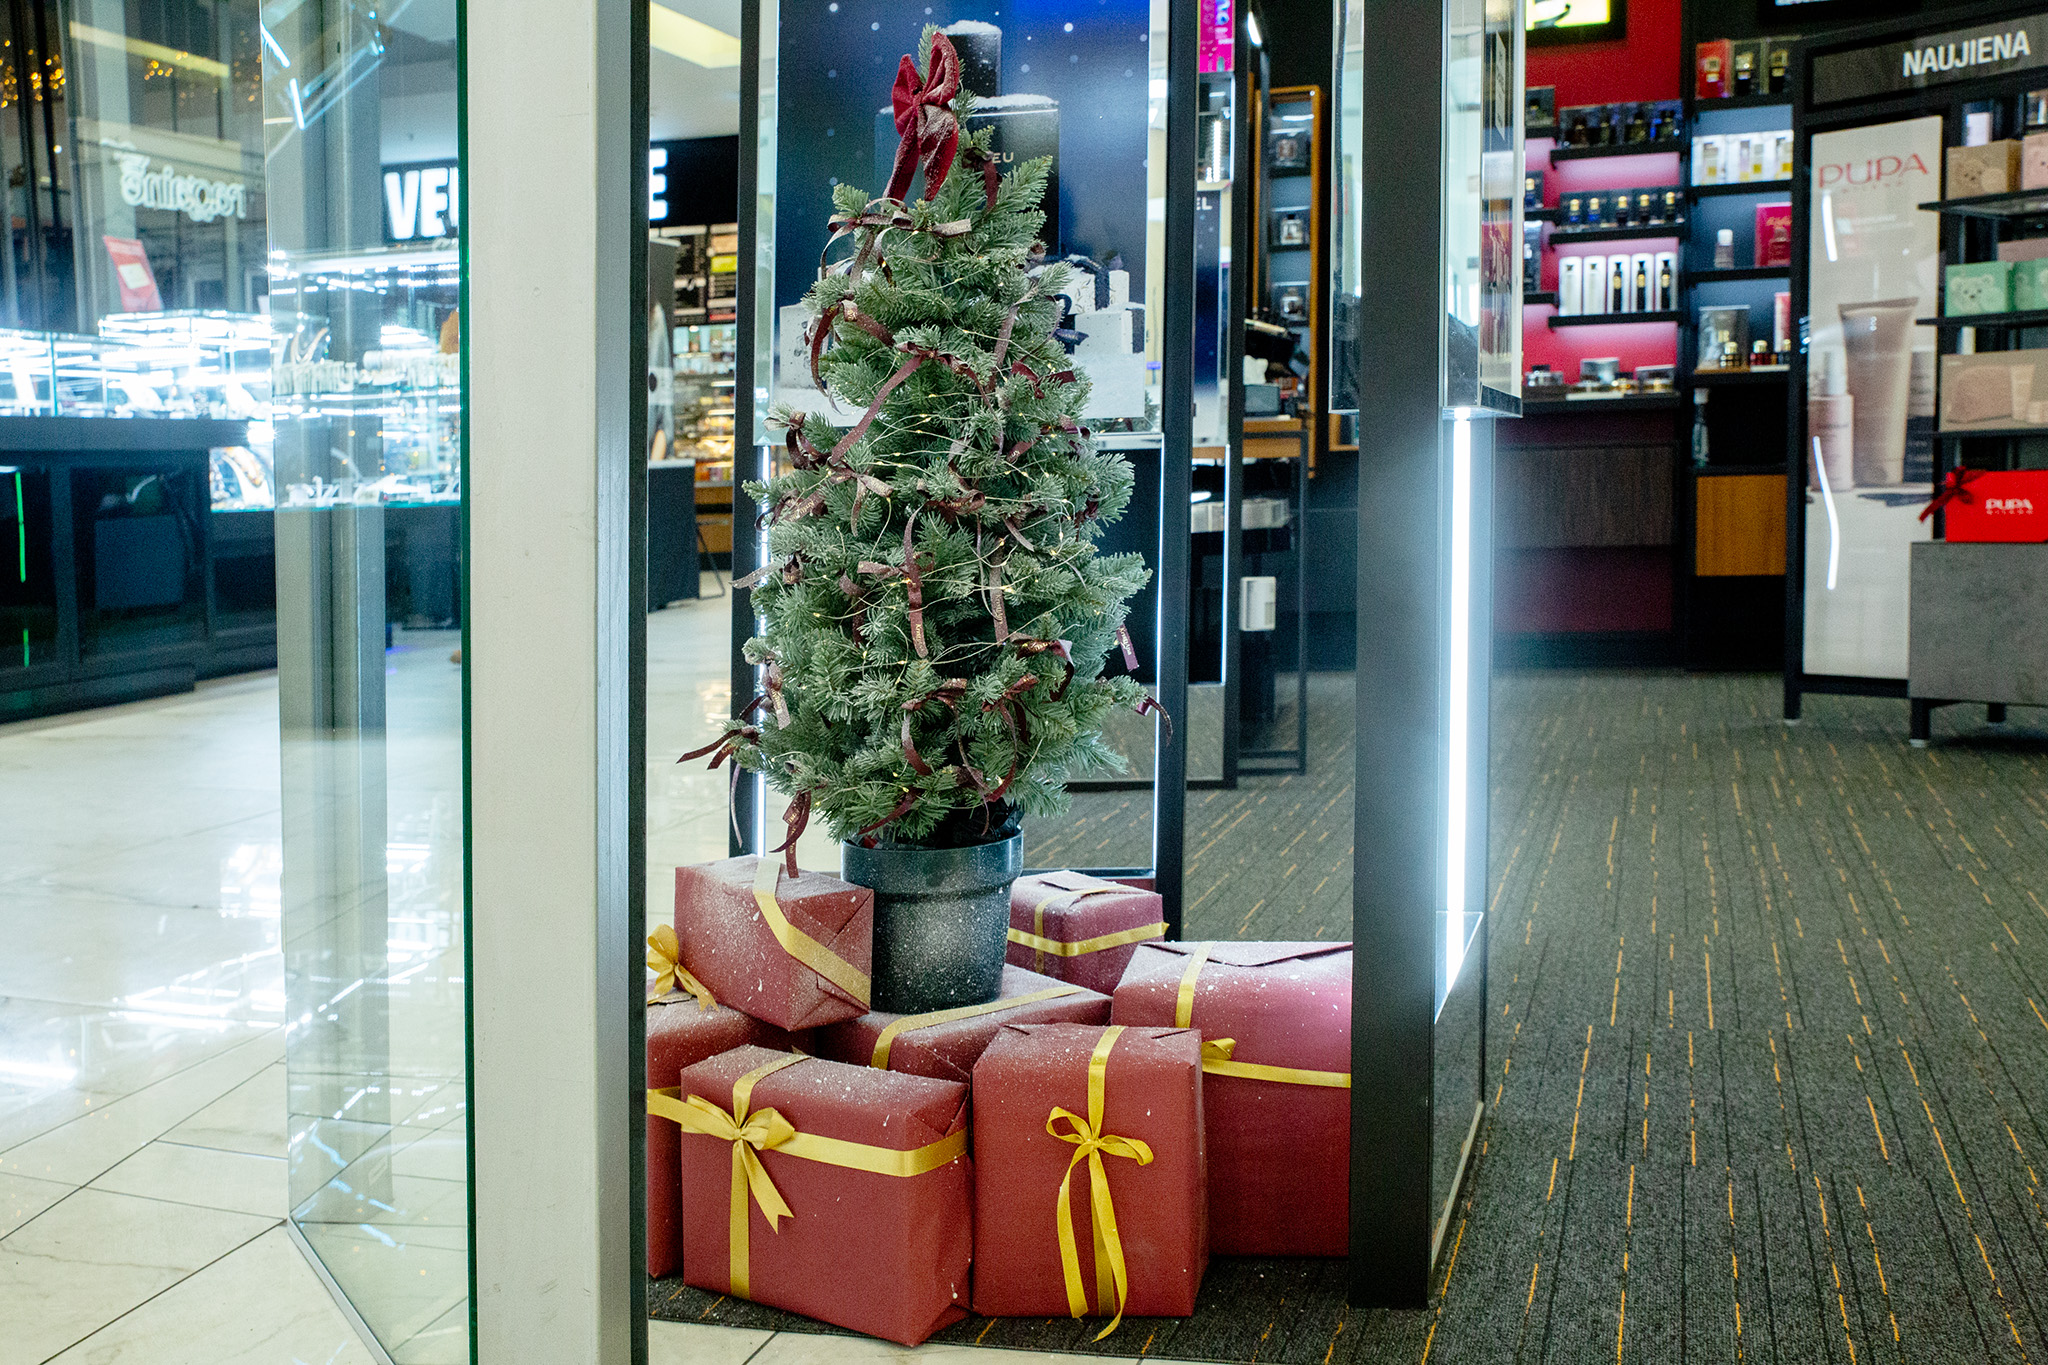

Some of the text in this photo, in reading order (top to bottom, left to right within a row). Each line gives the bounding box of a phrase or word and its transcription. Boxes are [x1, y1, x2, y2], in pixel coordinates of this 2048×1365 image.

[1903, 30, 2031, 77] NAUJIENA
[1818, 153, 1928, 188] PUPA
[1986, 498, 2033, 510] PUPA
